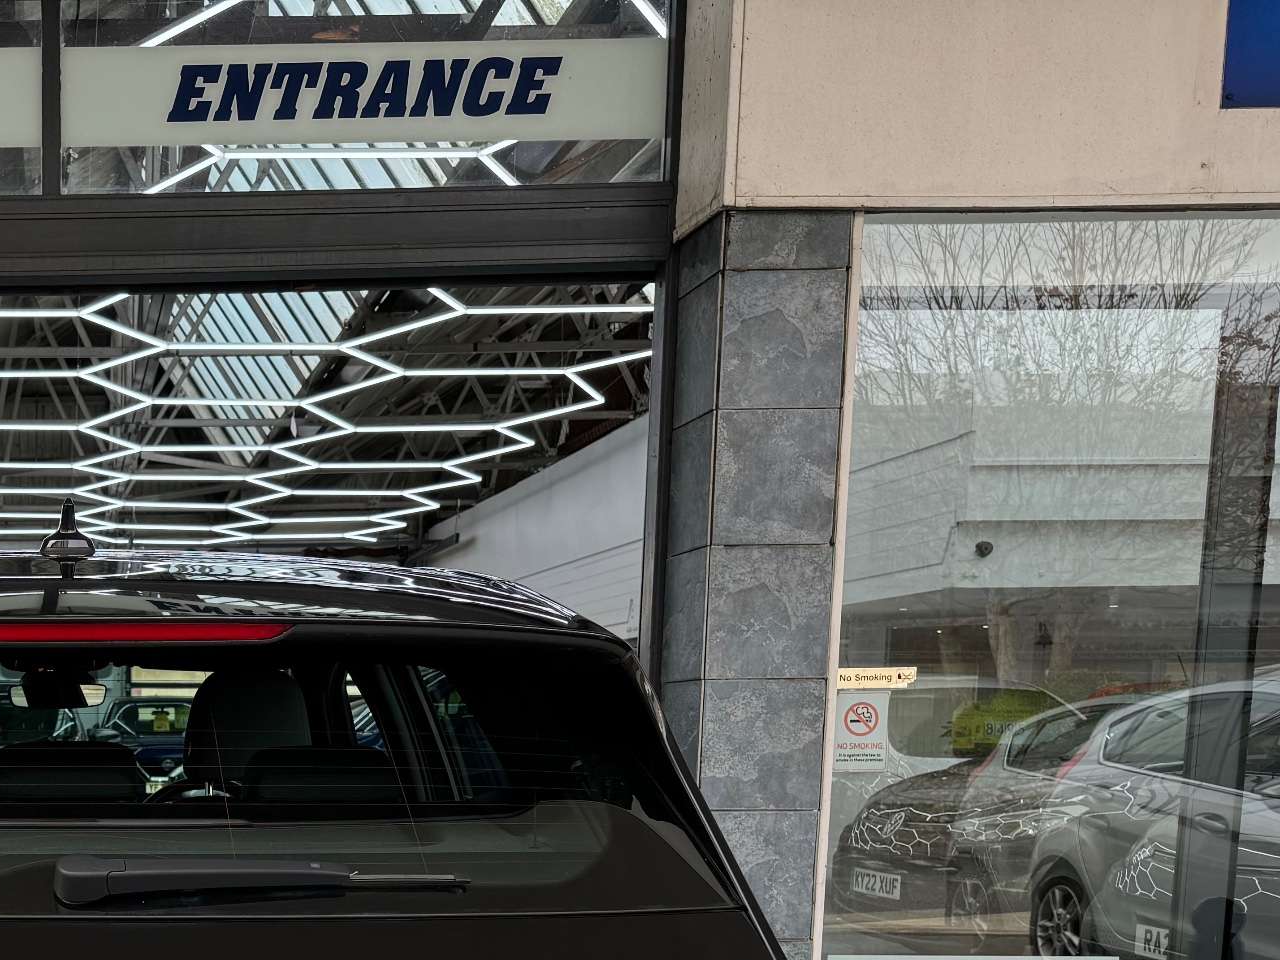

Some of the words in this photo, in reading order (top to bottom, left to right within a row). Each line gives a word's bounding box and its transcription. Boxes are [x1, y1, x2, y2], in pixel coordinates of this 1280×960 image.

[166, 56, 564, 122] ENTRANCE
[839, 674, 851, 682] No
[854, 673, 892, 683] Smoking
[854, 870, 877, 892] KY22
[878, 874, 899, 896] XUF
